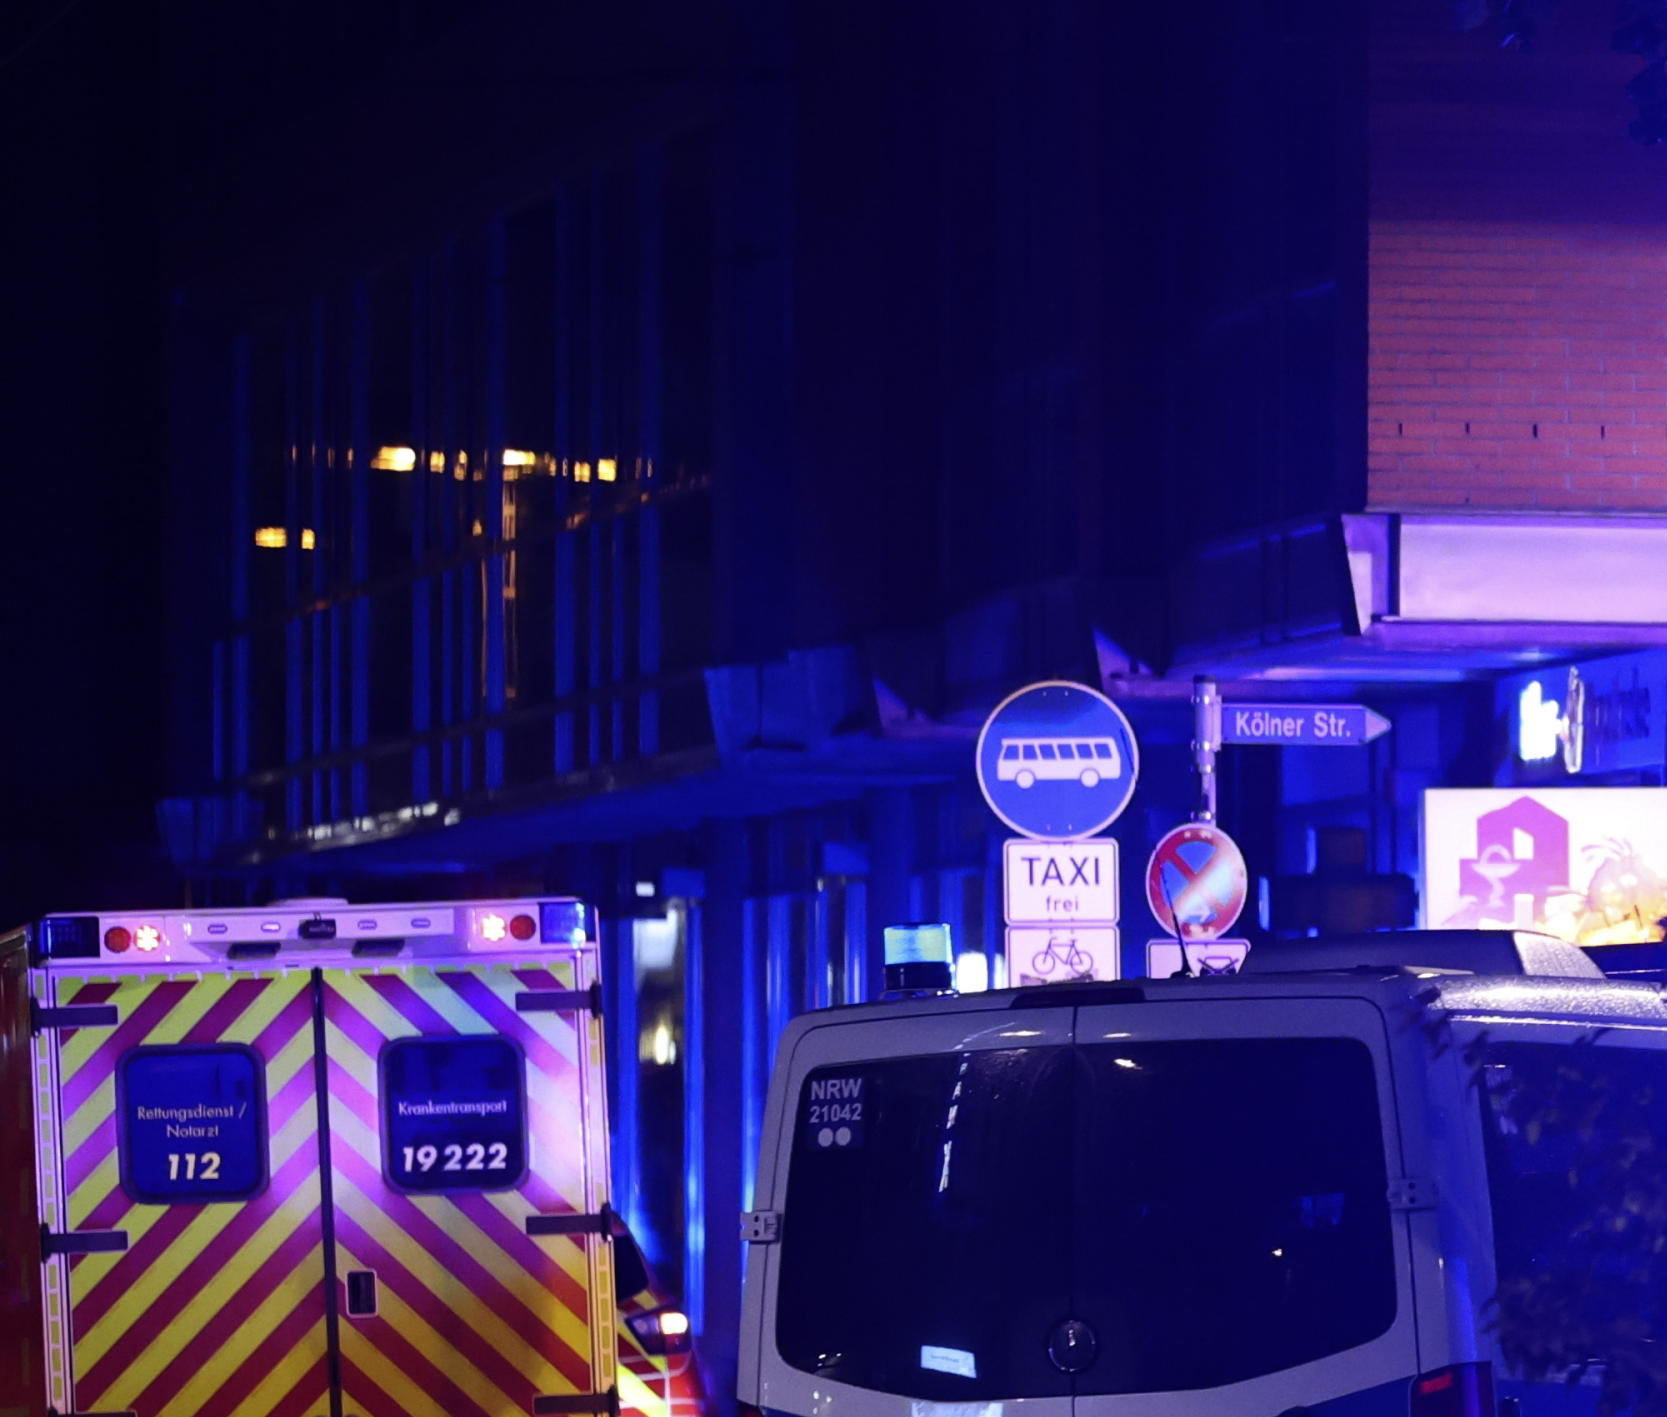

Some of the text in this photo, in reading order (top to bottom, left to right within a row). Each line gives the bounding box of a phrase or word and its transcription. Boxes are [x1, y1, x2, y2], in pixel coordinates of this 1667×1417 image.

[1235, 710, 1352, 738] Kölner Str.
[1020, 856, 1101, 887] TAXI
[1045, 894, 1080, 912] frei
[810, 1078, 862, 1100] NRW
[136, 1103, 236, 1123] Rettungsdienst
[398, 1100, 508, 1117] Krankentransport
[809, 1103, 862, 1124] 21042
[165, 1123, 219, 1139] Notarzt
[168, 1152, 220, 1181] 112
